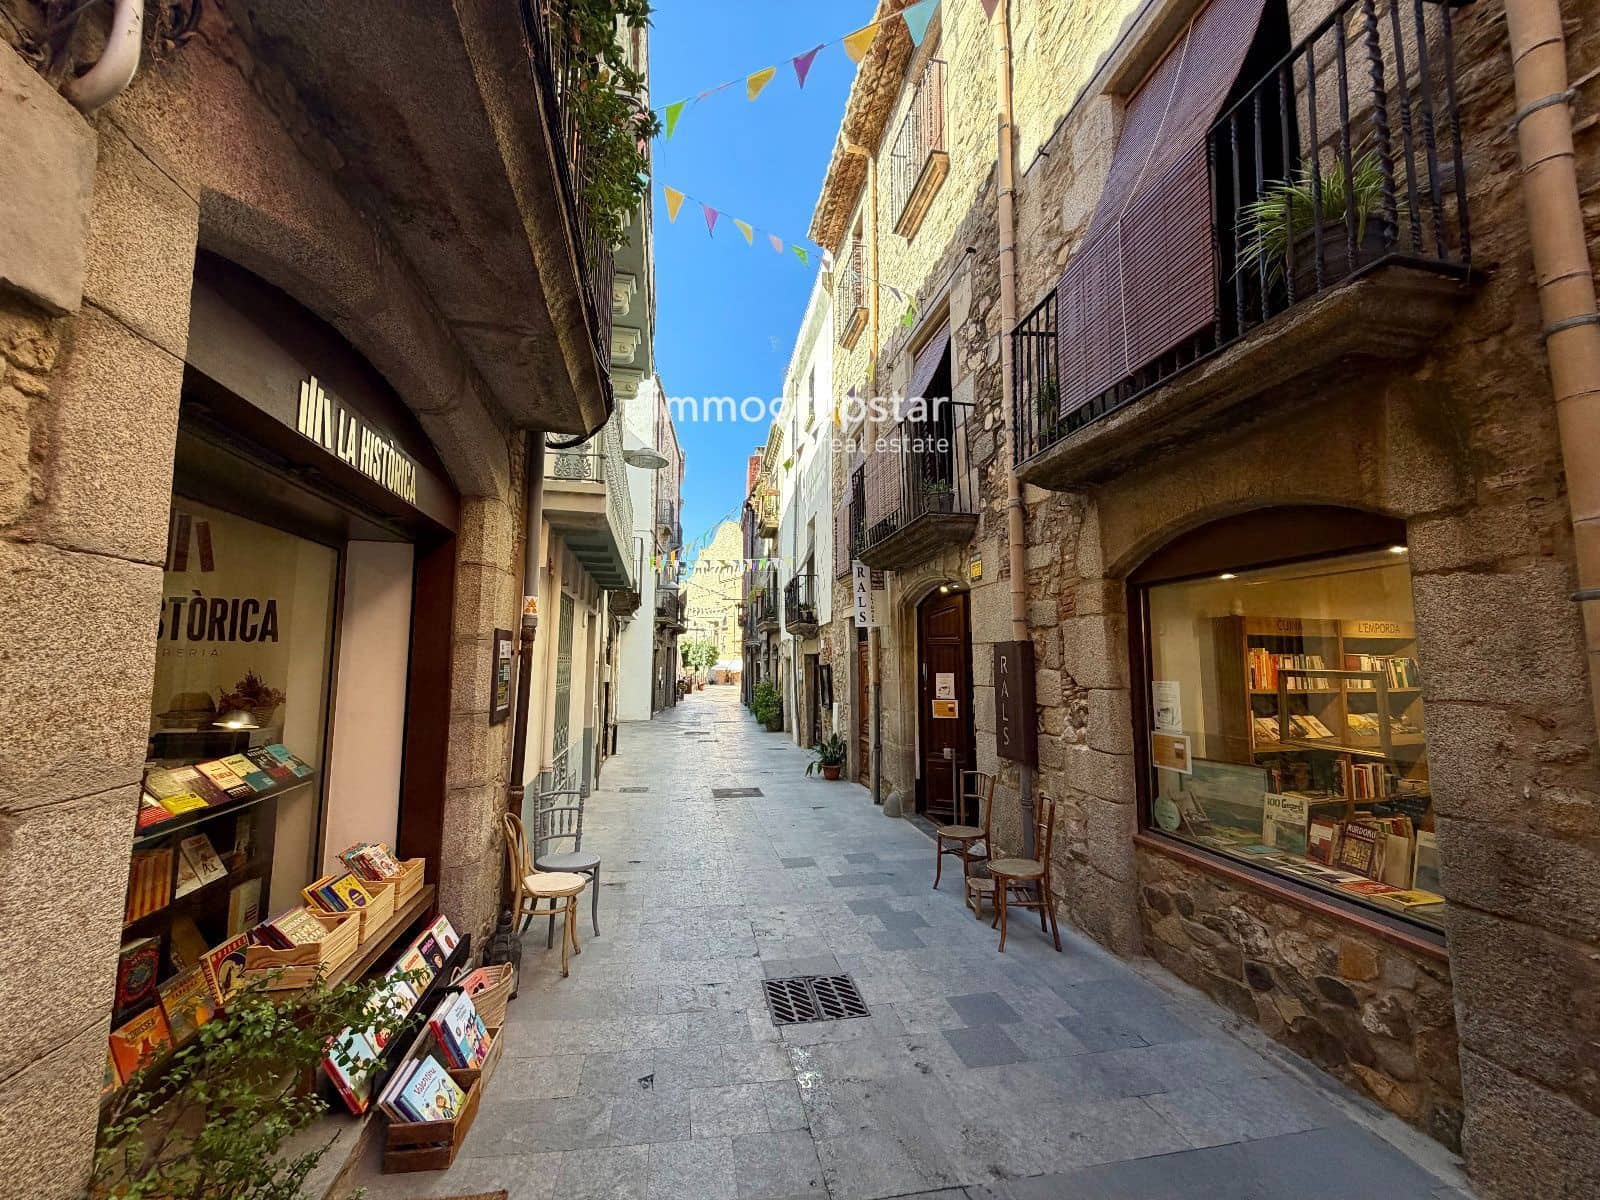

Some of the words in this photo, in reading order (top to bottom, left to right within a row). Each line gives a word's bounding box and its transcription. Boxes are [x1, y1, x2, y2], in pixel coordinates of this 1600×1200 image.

[338, 408, 357, 467] LA
[360, 424, 416, 505] HISTÒRICA
[856, 566, 867, 623] RALS
[1000, 655, 1010, 745] RALS
